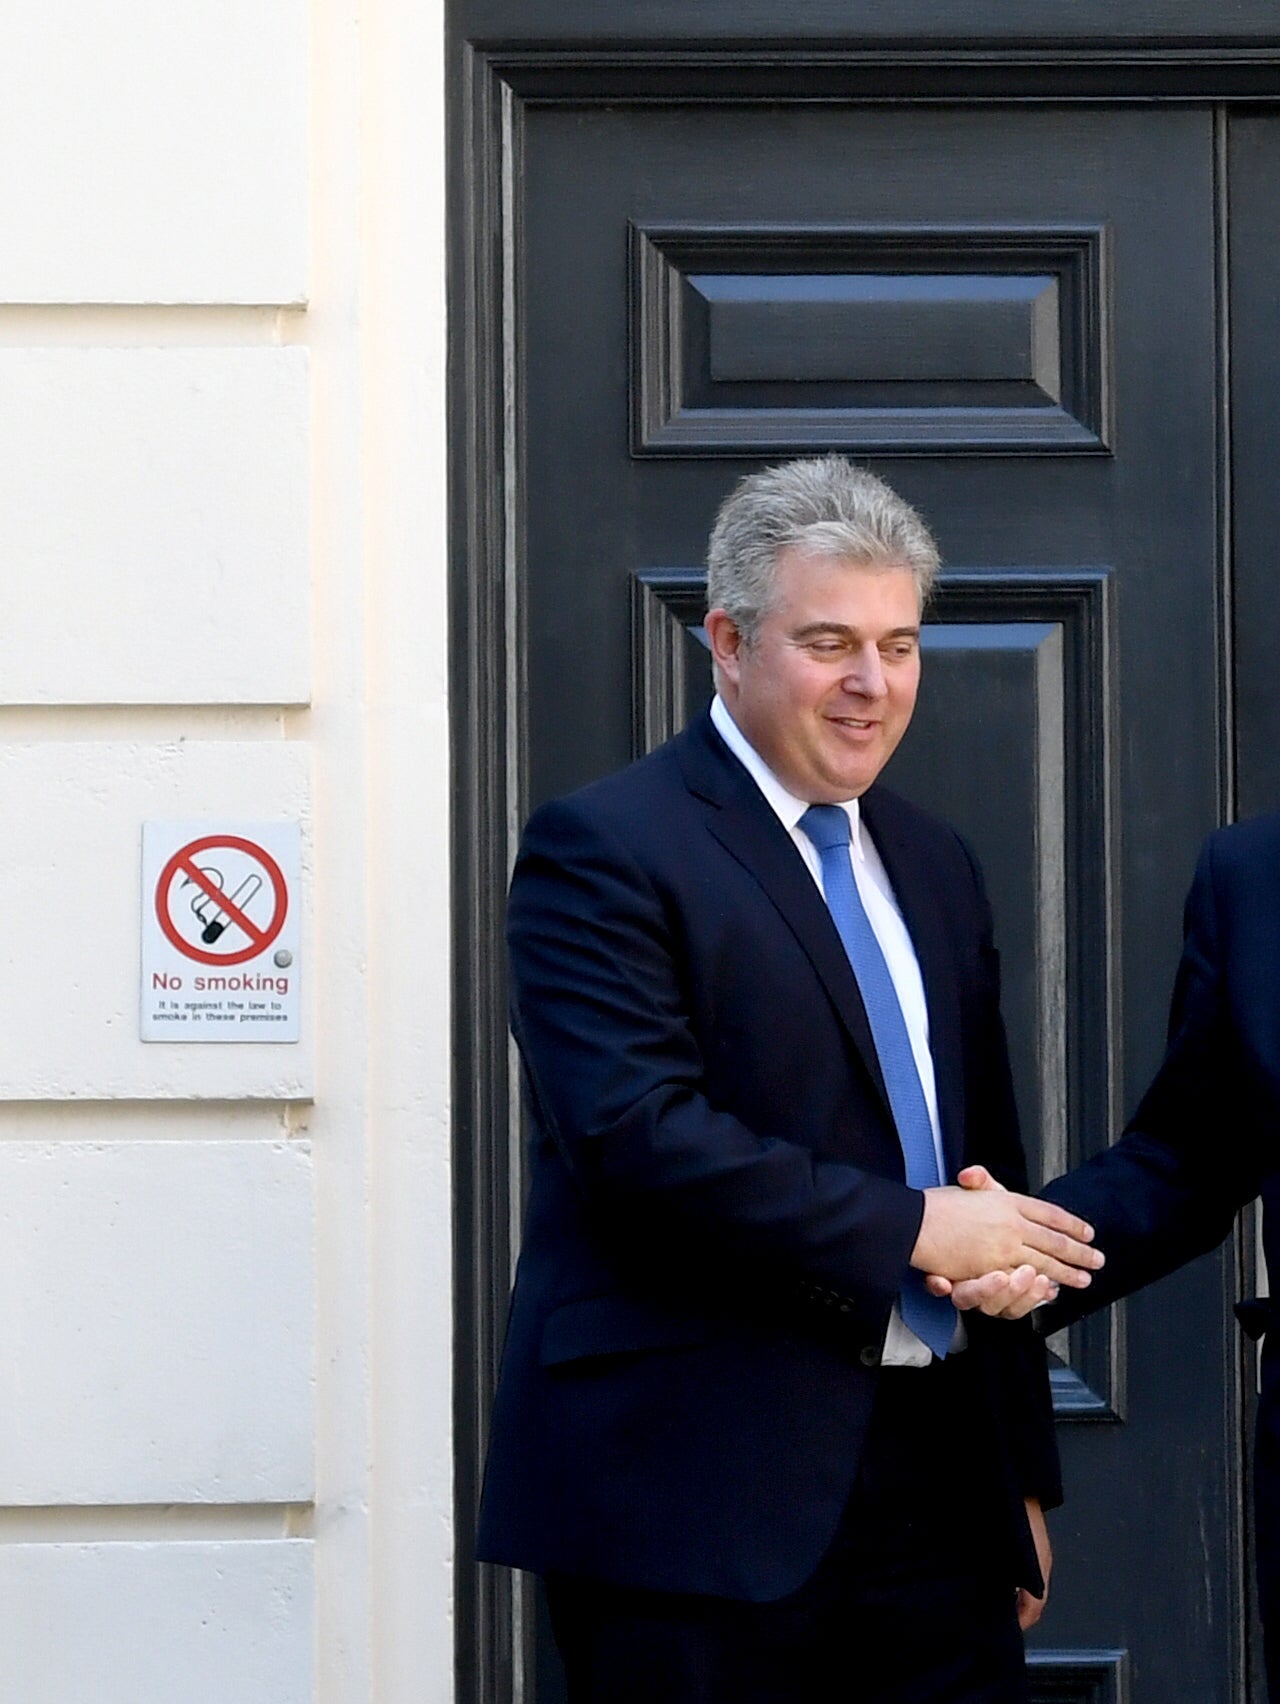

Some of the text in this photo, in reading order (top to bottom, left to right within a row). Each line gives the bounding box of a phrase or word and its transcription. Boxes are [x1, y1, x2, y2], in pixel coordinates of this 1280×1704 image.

[152, 972, 289, 995] No smoking
[158, 1001, 282, 1012] It is against the law to
[152, 1012, 288, 1022] smoke in these premises
